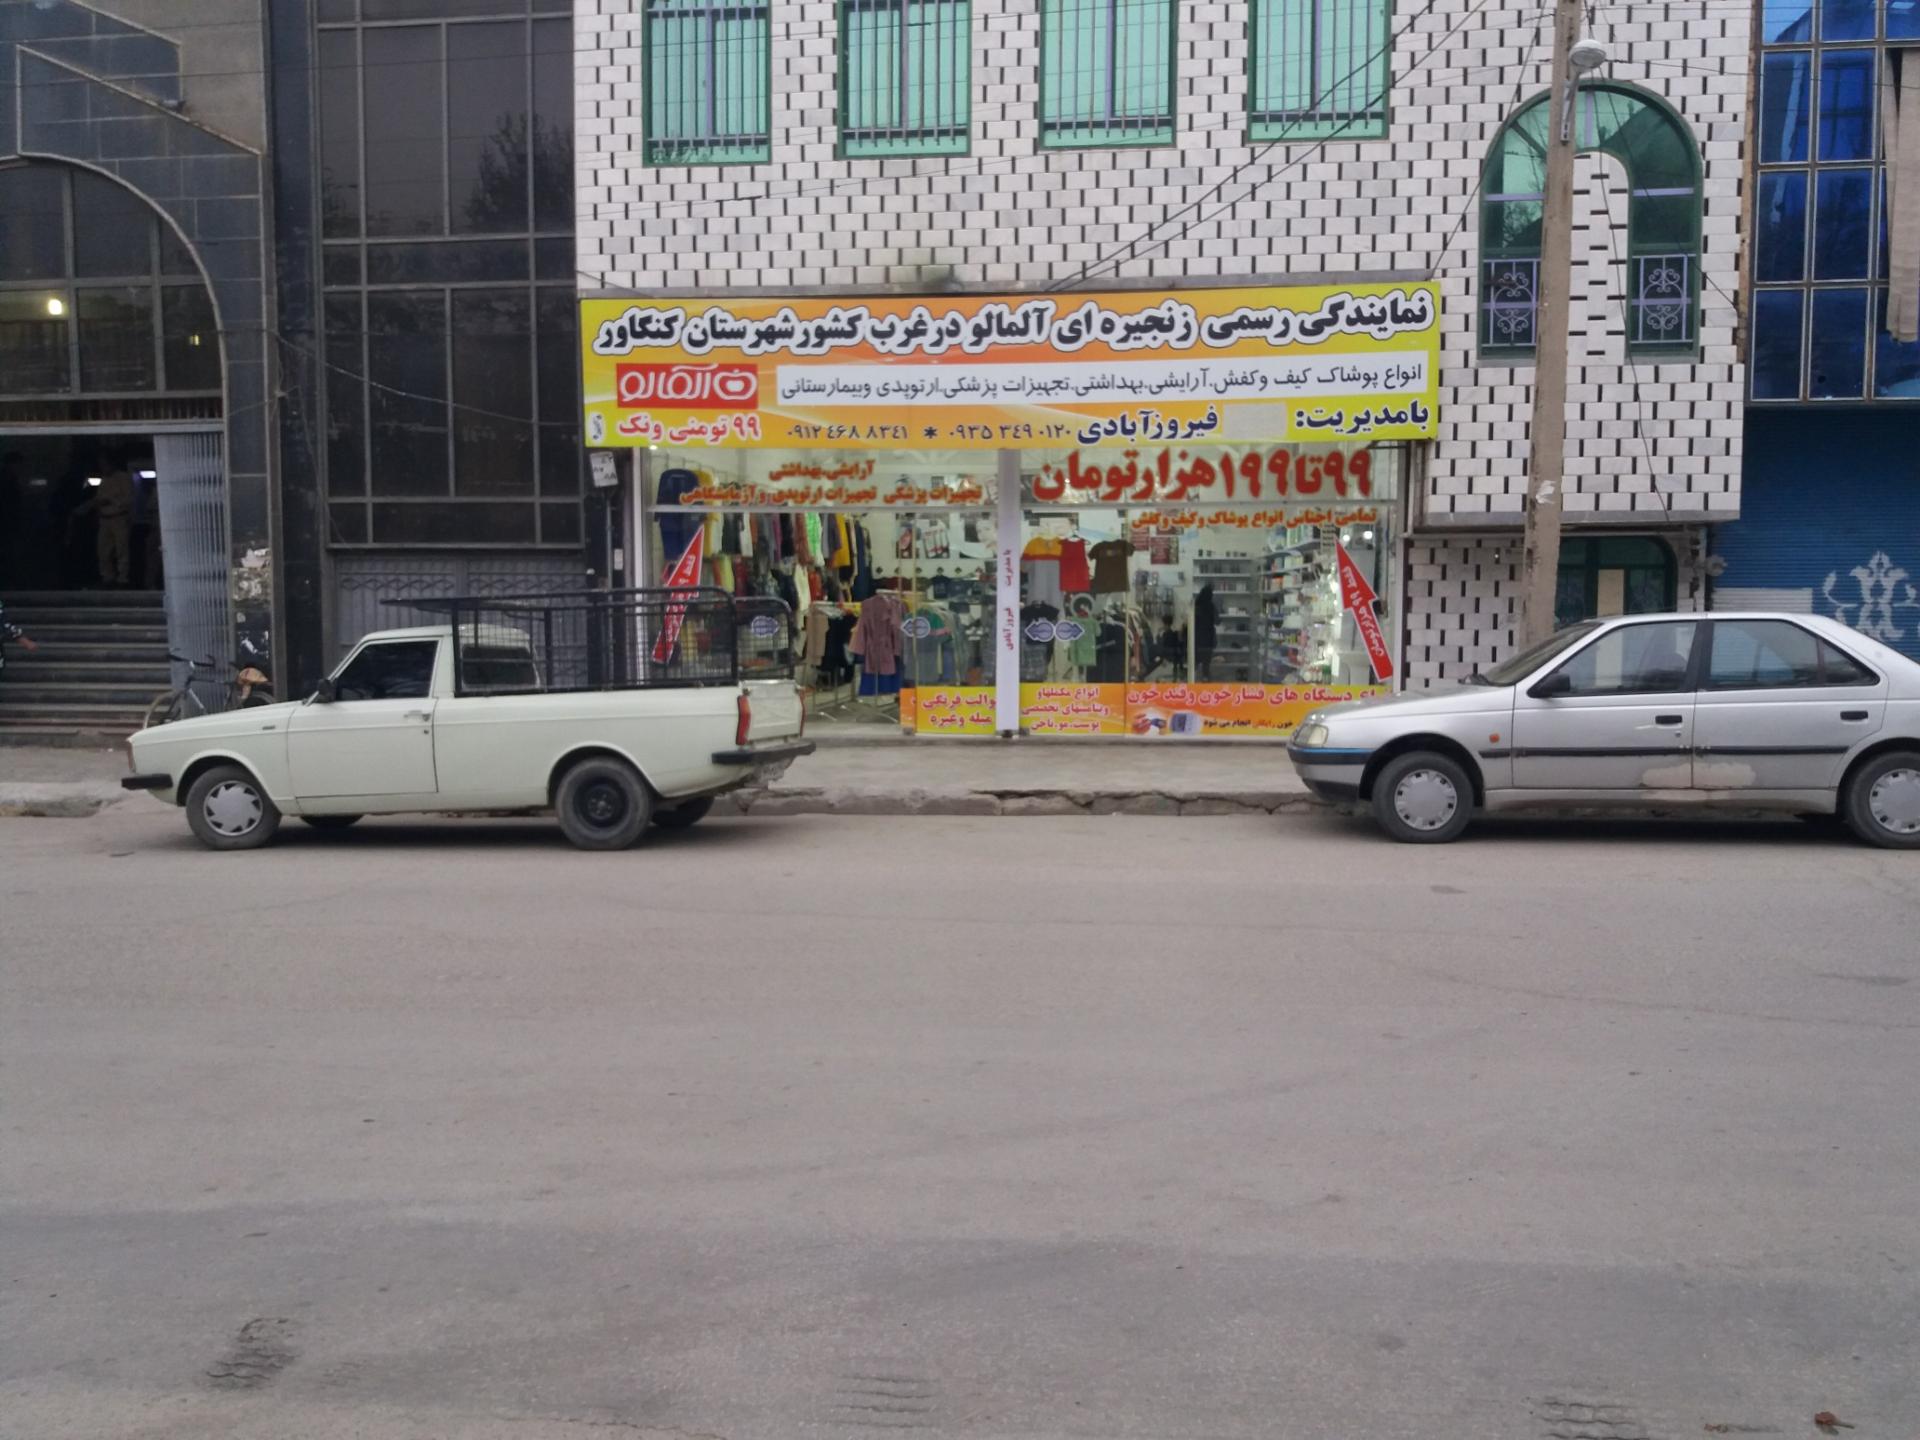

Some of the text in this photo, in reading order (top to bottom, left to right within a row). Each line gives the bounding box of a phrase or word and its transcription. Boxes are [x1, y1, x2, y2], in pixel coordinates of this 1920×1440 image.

[967, 306, 1050, 348] آلمالو
[1056, 307, 1094, 346] ای
[1099, 305, 1193, 344] زنجیره
[1207, 310, 1290, 341] رسمی
[1299, 295, 1428, 337] نمایندگی
[598, 313, 680, 349] کنگاور
[1273, 367, 1312, 390] کیف
[1316, 364, 1378, 389] پوشاک
[1383, 362, 1422, 390] انواع
[668, 417, 728, 442] تومنی
[732, 415, 760, 437] ۹۹
[824, 485, 877, 505] تجهیزات
[883, 485, 929, 505] پزشکی
[929, 484, 983, 504] تجهیزات
